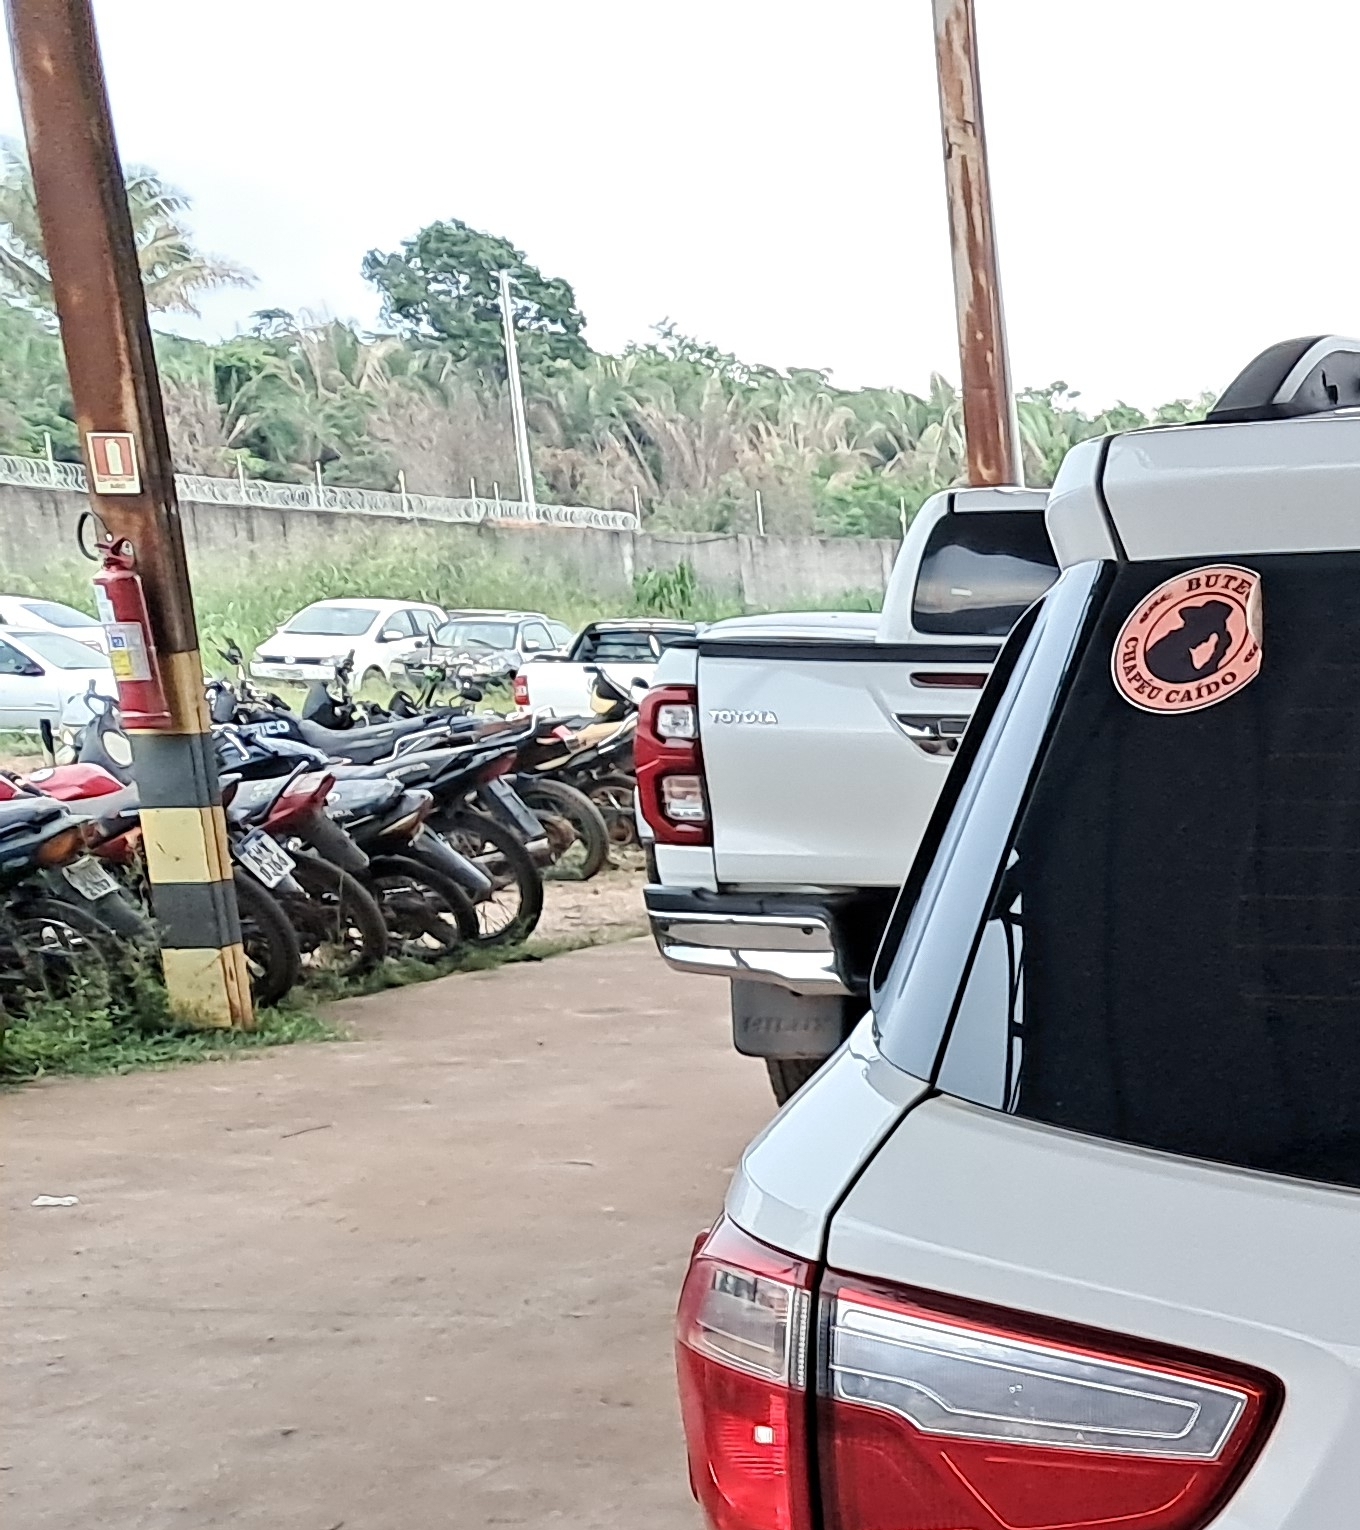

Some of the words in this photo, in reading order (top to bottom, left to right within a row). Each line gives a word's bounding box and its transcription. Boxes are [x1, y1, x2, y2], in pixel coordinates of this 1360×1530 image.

[1122, 636, 1164, 701] CHAPÉU
[1165, 671, 1237, 704] CAÍDO
[707, 708, 779, 725] TOYOTA
